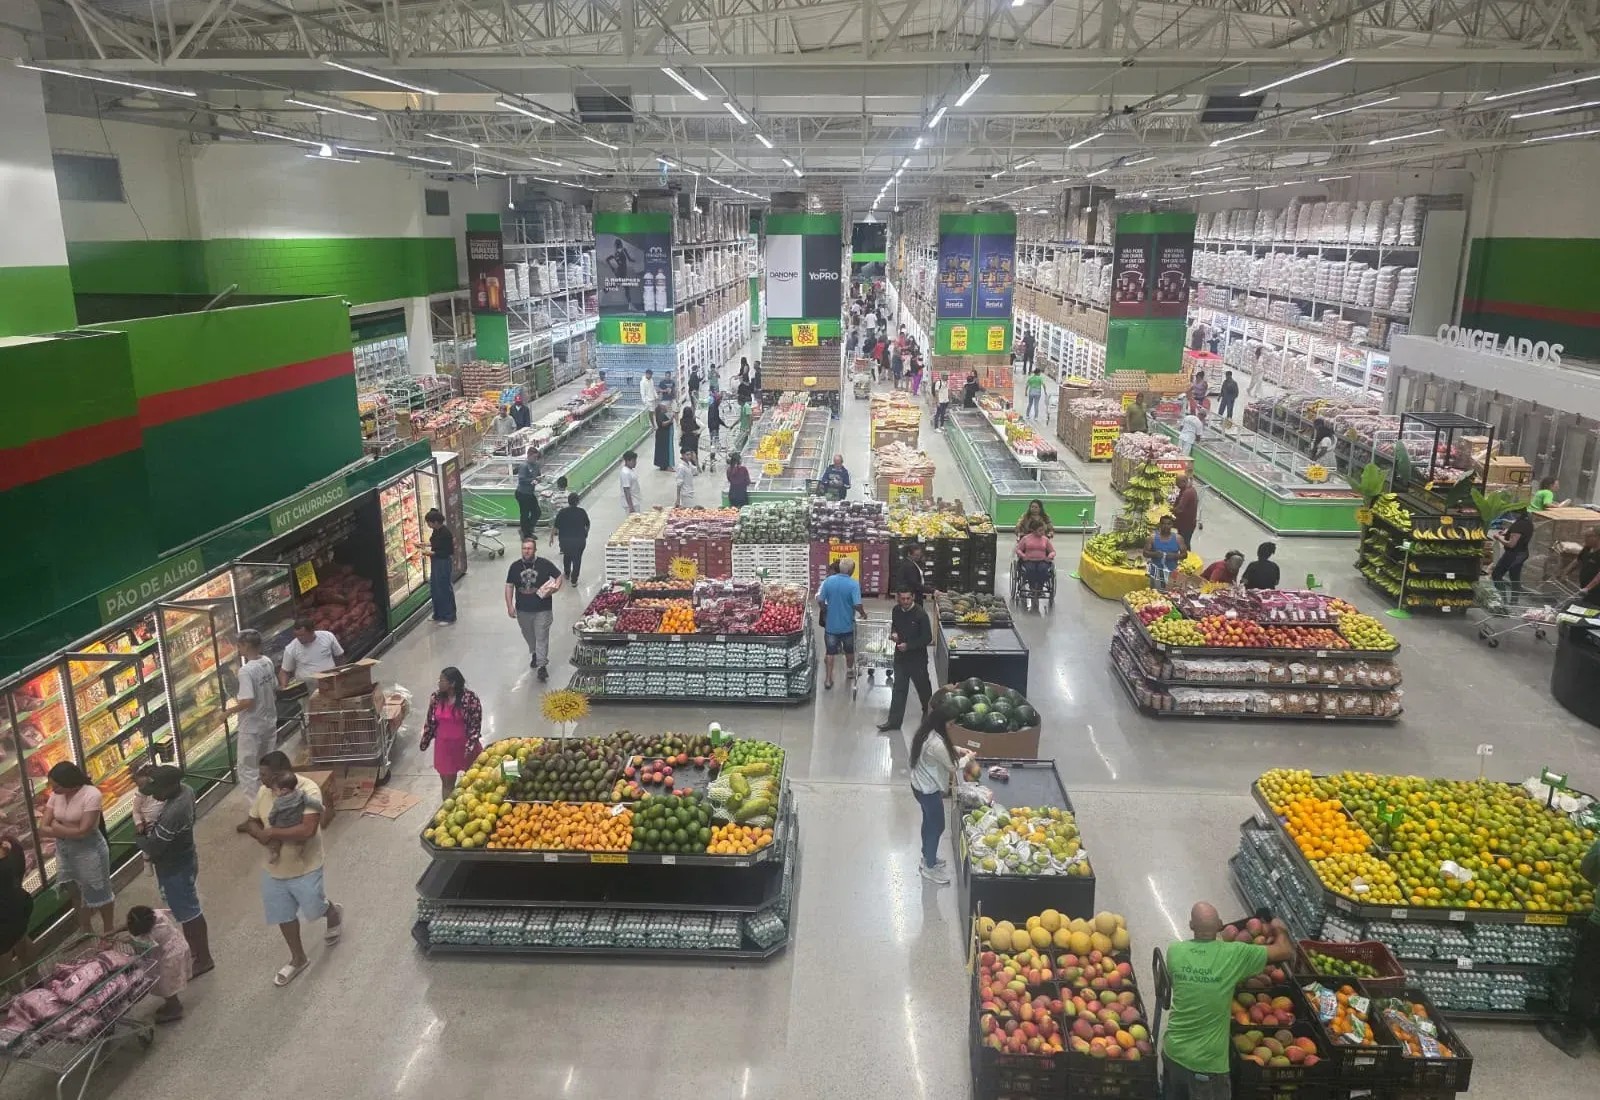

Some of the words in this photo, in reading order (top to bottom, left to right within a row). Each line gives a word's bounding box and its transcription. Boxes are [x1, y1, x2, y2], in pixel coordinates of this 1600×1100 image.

[809, 272, 838, 280] YoPRO
[1437, 324, 1564, 366] CONGELADOS
[276, 511, 291, 528] KIT
[292, 486, 344, 520] CHURRASCO
[106, 588, 138, 616] PÃO
[140, 580, 160, 600] DE
[163, 559, 198, 588] ALHO
